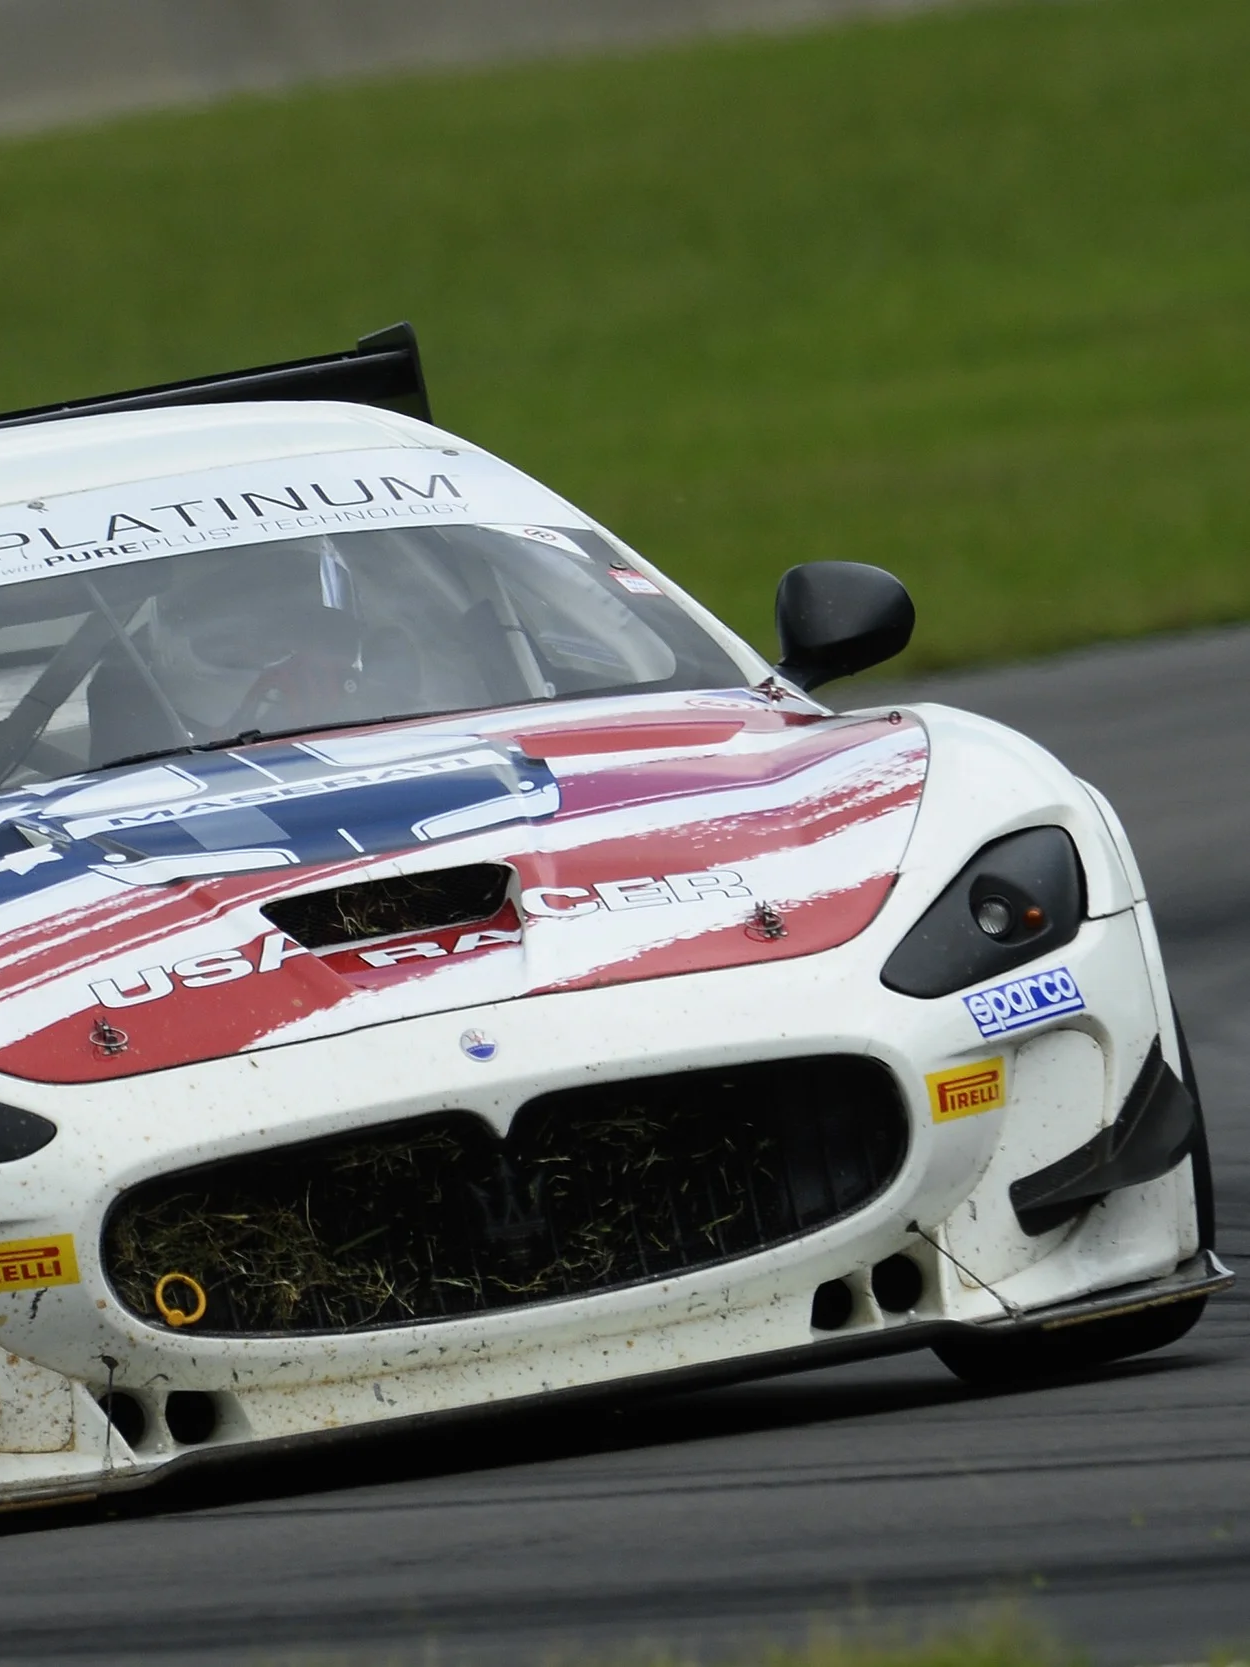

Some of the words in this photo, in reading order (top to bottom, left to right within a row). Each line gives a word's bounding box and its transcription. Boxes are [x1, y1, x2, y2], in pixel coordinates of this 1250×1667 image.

[254, 503, 470, 533] TECHNOLOGY
[108, 757, 478, 827] MASERATI
[88, 932, 309, 1010] USA
[358, 868, 753, 969] RACER
[968, 969, 1081, 1031] sparco
[937, 1069, 1000, 1113] PIRELLI
